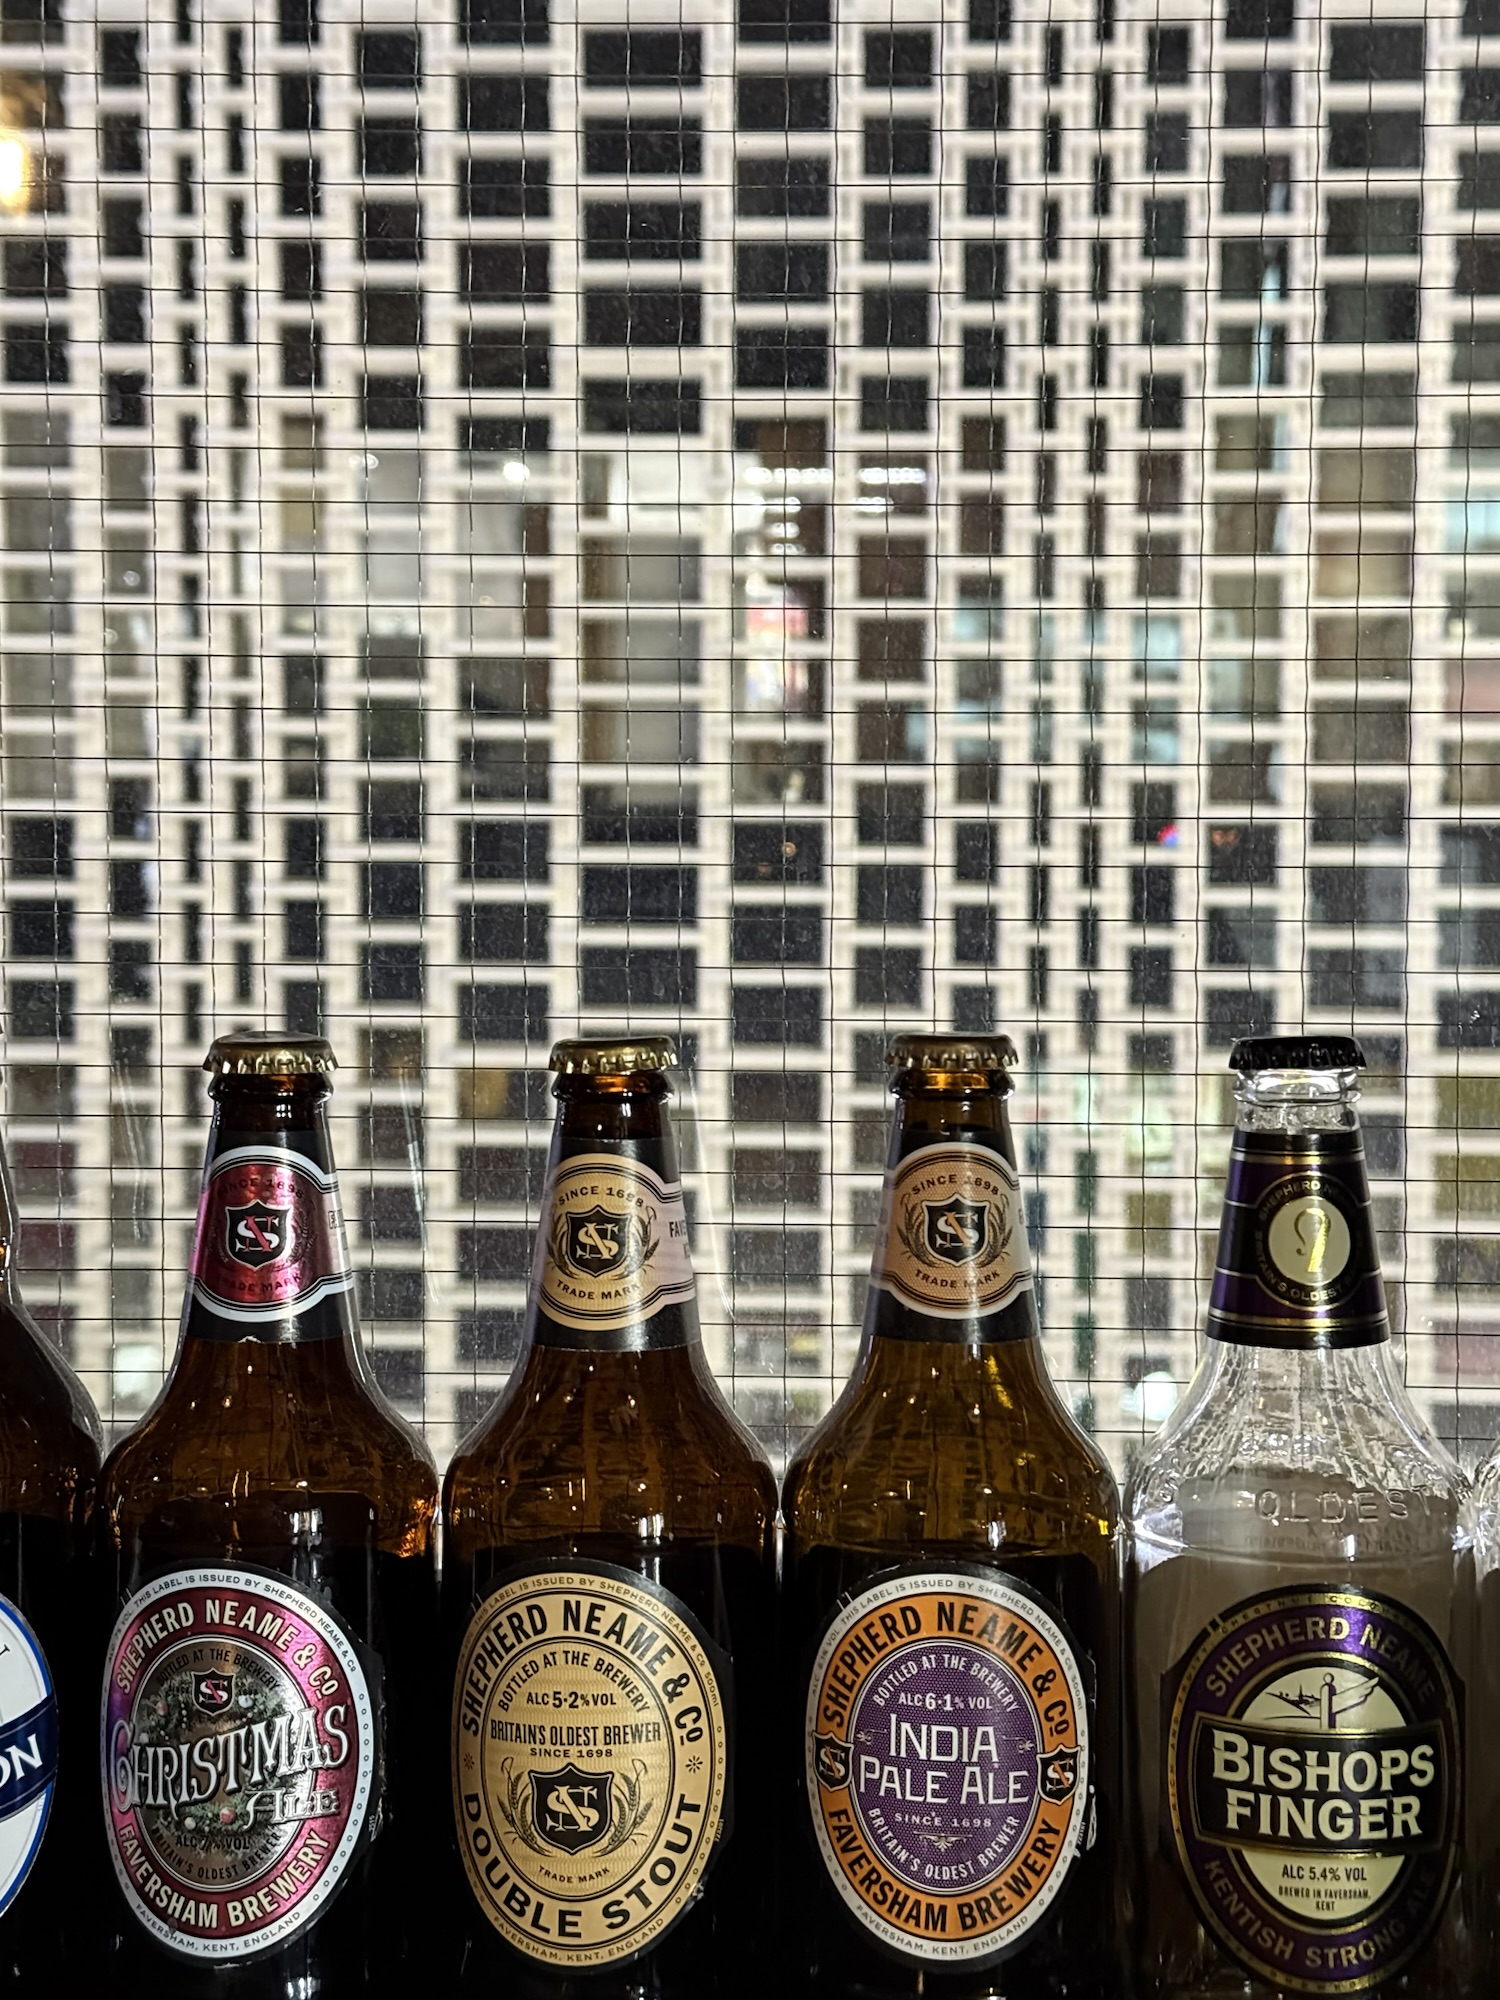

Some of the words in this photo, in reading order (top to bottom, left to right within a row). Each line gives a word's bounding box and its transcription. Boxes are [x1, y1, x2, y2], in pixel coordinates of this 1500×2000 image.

[558, 1186, 599, 1206] SINCE
[606, 1187, 644, 1208] 1698
[911, 1174, 957, 1195] SINCE
[262, 1274, 302, 1293] MARK
[556, 1279, 595, 1300] TRADE
[601, 1283, 641, 1300] MARK
[915, 1269, 957, 1288] TRADE
[134, 1590, 152, 1608] THIS
[153, 1578, 182, 1594] LABEL
[185, 1575, 196, 1584] IS
[199, 1573, 241, 1584] ISSUED
[244, 1579, 262, 1589] BY
[263, 1584, 318, 1619] SHEPHERD
[317, 1617, 345, 1649] NEAME
[489, 1588, 517, 1610] LABEL
[519, 1582, 530, 1592] IS
[532, 1576, 575, 1588] ISSUED
[579, 1579, 596, 1587] BY
[600, 1580, 660, 1613] SHEPHERD
[661, 1611, 693, 1644] NEAME
[840, 1607, 860, 1626] THIS
[860, 1588, 893, 1609] LABEL
[895, 1584, 907, 1593] IS
[909, 1579, 954, 1590] ISSUED
[958, 1581, 975, 1590] BY
[977, 1585, 1035, 1617] SHEPHERD
[1034, 1615, 1062, 1647] NEAME
[116, 1601, 195, 1695] SHEPHERD
[205, 1599, 299, 1652] NEAME
[292, 1642, 317, 1671] &
[193, 1649, 204, 1661] AT
[210, 1648, 231, 1662] THE
[234, 1653, 281, 1691] BREWERY
[462, 1604, 548, 1737] SHEPHERD
[562, 1600, 676, 1676] NEAME
[662, 1672, 690, 1704] &
[823, 1605, 922, 1728] SHEPHERD
[937, 1601, 1044, 1673] NEAME
[1032, 1668, 1057, 1698] &
[1205, 1616, 1350, 1698] SHEPHERD
[498, 1659, 540, 1712] BOTTLED
[543, 1651, 557, 1669] AT
[563, 1650, 590, 1667] THE
[593, 1657, 650, 1713] BREWERY
[526, 1692, 549, 1706] ALC
[591, 1693, 617, 1706] VOL
[872, 1660, 918, 1707] BOTTLED
[922, 1654, 937, 1671] AT
[943, 1653, 968, 1671] THE
[970, 1662, 1020, 1712] BREWERY
[898, 1691, 923, 1706] ALC
[968, 1696, 994, 1710] VOL
[530, 1747, 571, 1758] SINCE
[576, 1748, 613, 1759] 1698
[550, 1725, 599, 1747] OLDEST
[603, 1721, 662, 1747] BREWER
[889, 1713, 1000, 1763] INDIA
[110, 1704, 349, 1821] CHRISTMAS
[859, 1754, 950, 1804] PALE
[960, 1765, 1030, 1805] ALE
[1211, 1727, 1435, 1794] BISHOPS
[894, 1813, 942, 1827] SINCE
[951, 1817, 993, 1828] 1698
[1225, 1786, 1423, 1842] FINGER
[175, 1834, 198, 1849] ALC
[225, 1837, 251, 1850] VOL
[197, 1865, 239, 1880] OLDEST
[242, 1832, 281, 1871] BREWER
[464, 1792, 582, 1939] DOUBLE
[602, 1793, 702, 1930] STOUT
[868, 1808, 920, 1872] BRITAIN'S
[924, 1861, 977, 1880] OLDEST
[976, 1816, 1020, 1867] BREWER
[119, 1824, 218, 1929] FAVERSHAM
[226, 1830, 330, 1928] BREWERY
[538, 1864, 574, 1884] TRADE
[578, 1866, 611, 1884] MARK
[829, 1808, 948, 1933] FAVERSHAM
[957, 1818, 1061, 1932] BREWERY
[1278, 1885, 1311, 1899] BREWED
[1313, 1888, 1323, 1900] IN
[1281, 1864, 1305, 1881] ALC
[1308, 1866, 1341, 1882] 5.4%
[1344, 1866, 1368, 1881] VOL
[244, 1911, 301, 1949] ENGLAND
[1204, 1859, 1295, 1961] KENTISH
[1305, 1918, 1405, 1969] STRONG
[1315, 1900, 1336, 1912] KENT
[608, 1918, 664, 1958] ENGLAND
[973, 1915, 1029, 1952] ENGLAND
